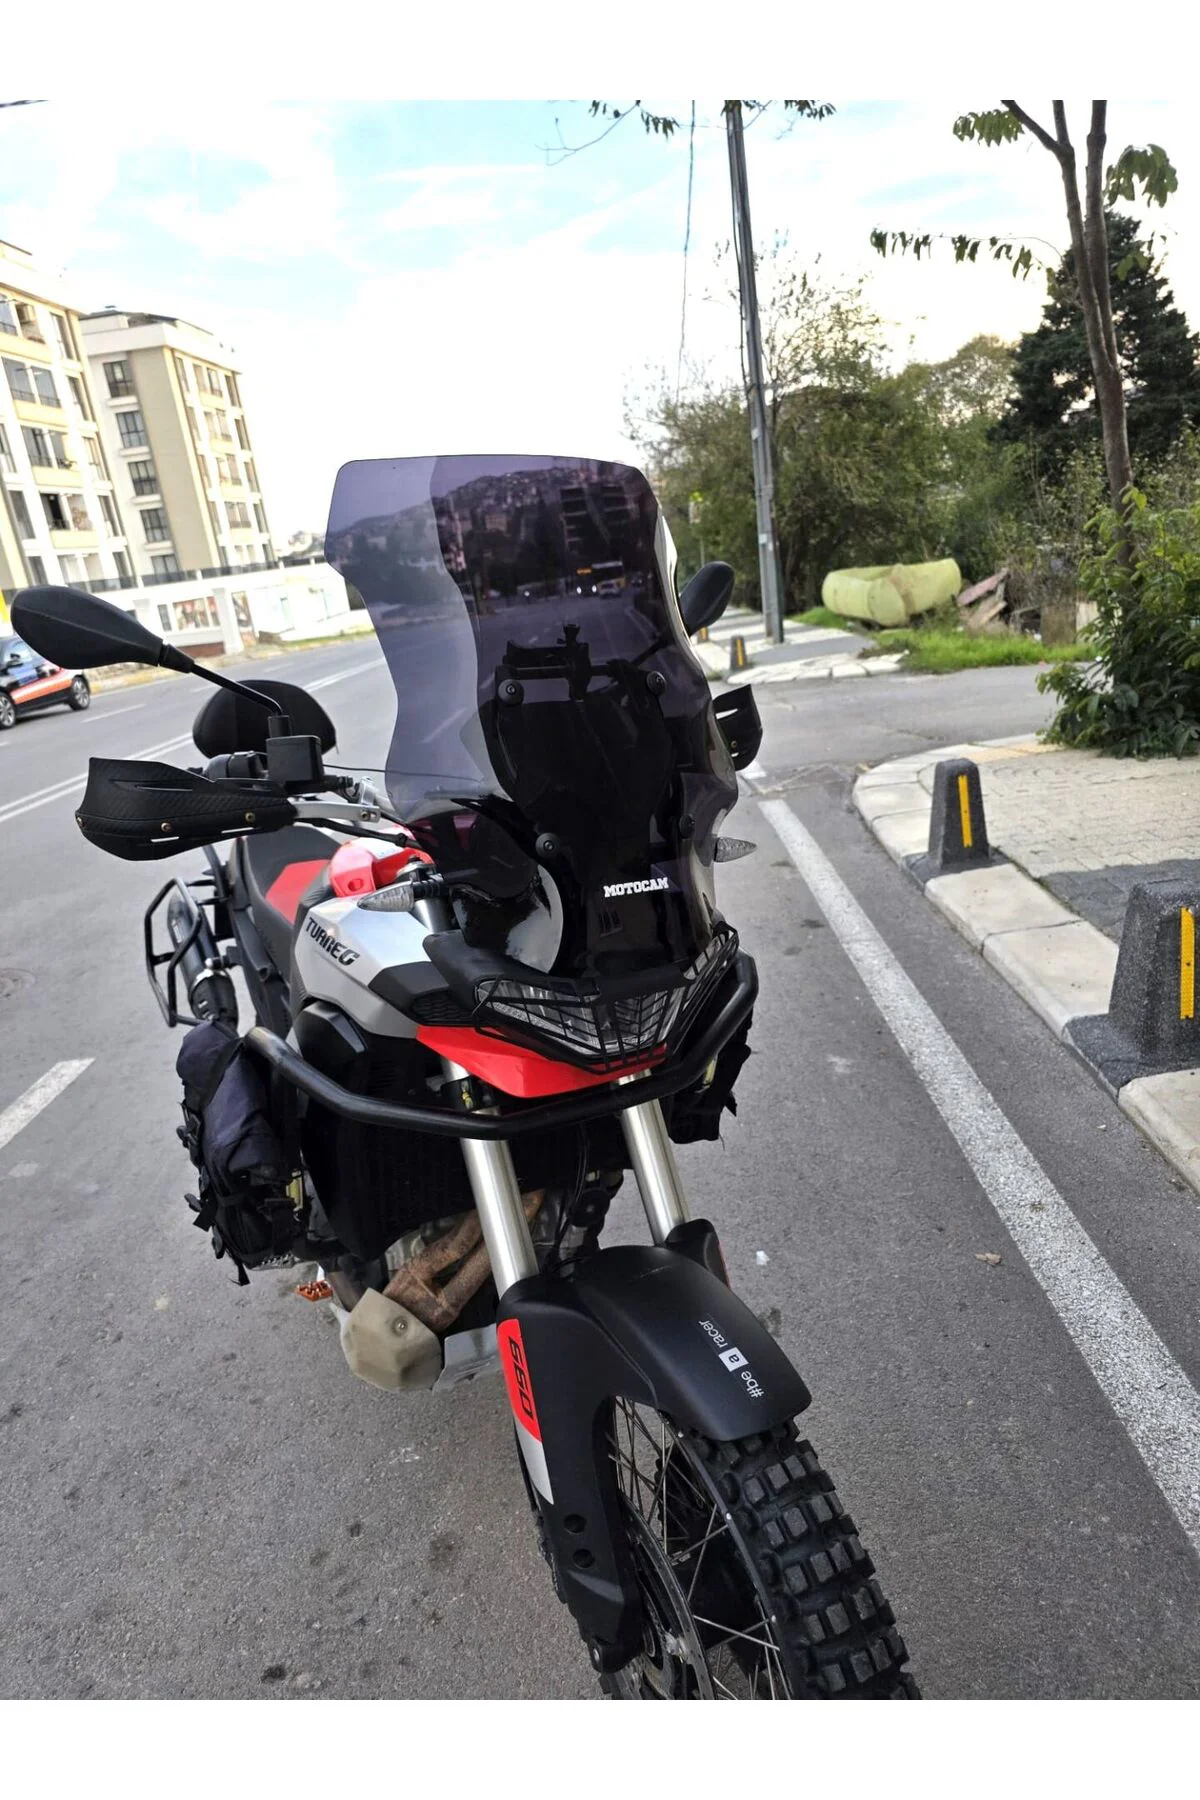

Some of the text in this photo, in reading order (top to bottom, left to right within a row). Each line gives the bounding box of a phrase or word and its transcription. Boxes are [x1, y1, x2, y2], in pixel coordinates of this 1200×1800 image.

[603, 877, 669, 898] MOTOCAM
[306, 916, 360, 966] TUAREG
[698, 1320, 728, 1348] racer
[508, 1335, 534, 1421] 660
[740, 1370, 764, 1398] #be
